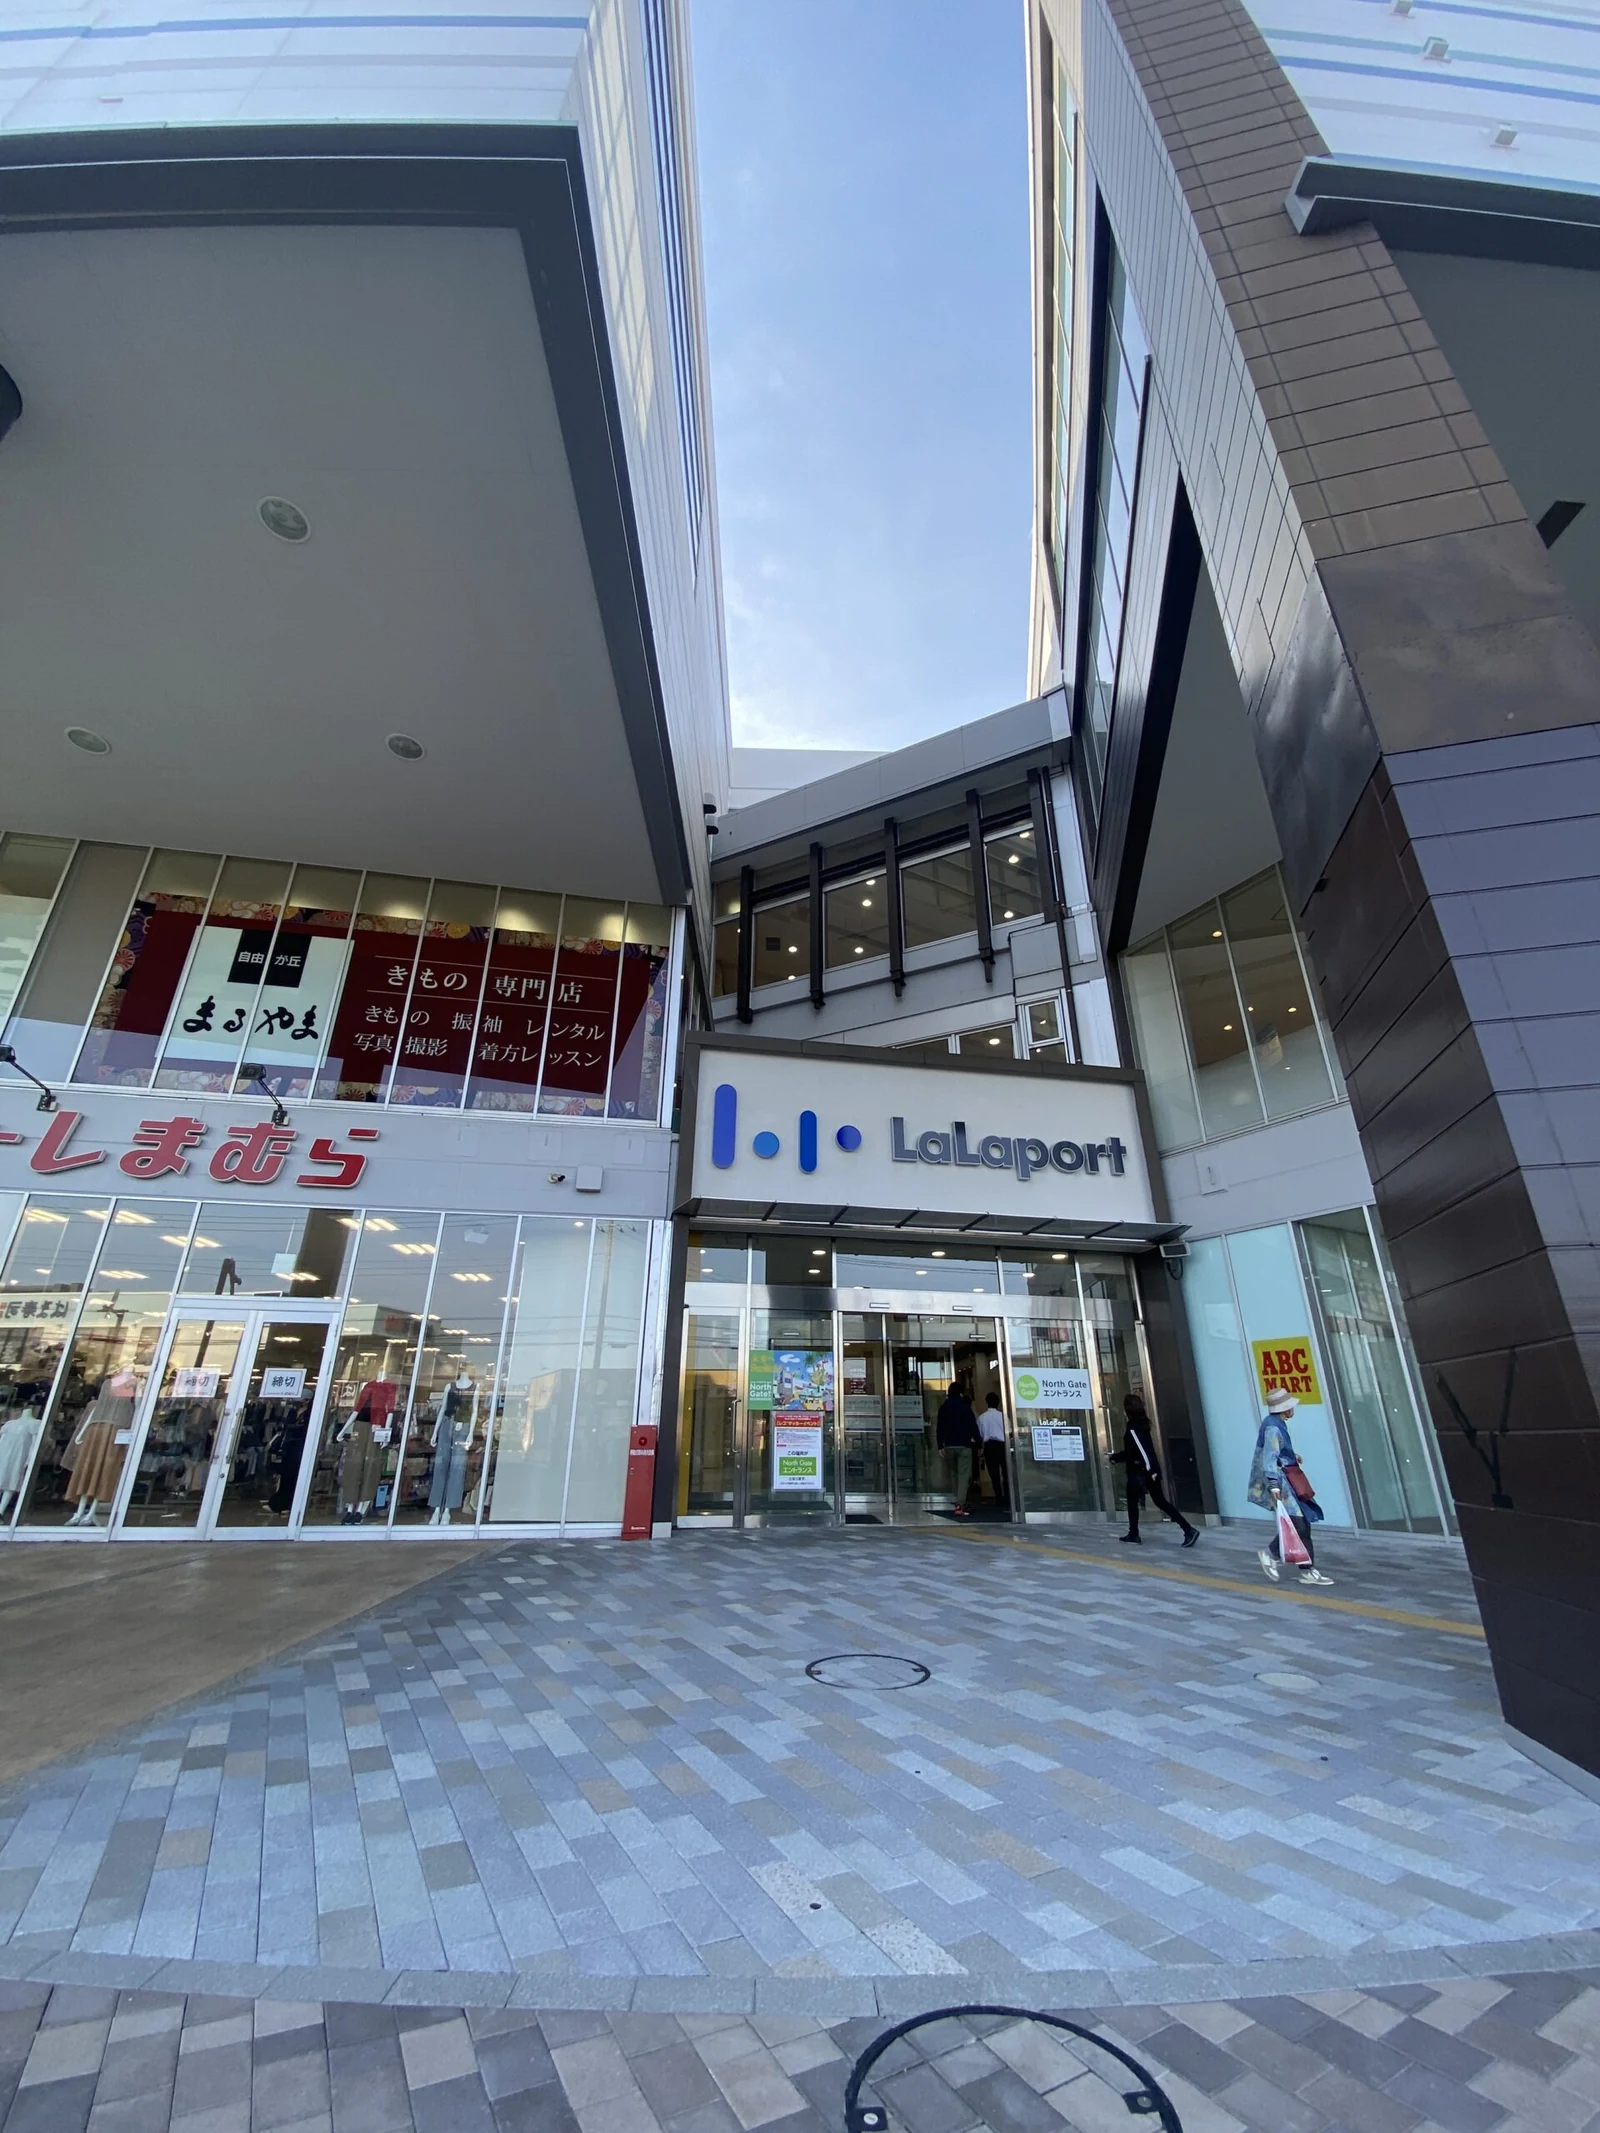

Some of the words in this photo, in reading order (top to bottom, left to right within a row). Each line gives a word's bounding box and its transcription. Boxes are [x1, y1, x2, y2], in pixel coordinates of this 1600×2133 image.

[238, 951, 301, 967] 自由が丘
[387, 965, 468, 990] きもの
[492, 975, 583, 1003] 専門店
[183, 995, 318, 1040] まるやま
[364, 1005, 430, 1026] きもの
[452, 1012, 503, 1033] 振袖
[526, 1019, 605, 1041] レンタル
[353, 1032, 448, 1057] 写真撮影
[478, 1042, 602, 1067] 着方レッスン
[890, 1116, 1127, 1181] LaLaport
[1262, 1348, 1308, 1375] ABC
[271, 1376, 295, 1387] 締切
[750, 1383, 772, 1391] North
[1042, 1380, 1065, 1388] North
[1068, 1380, 1087, 1389] Gate
[1264, 1376, 1312, 1393] MART
[1043, 1389, 1082, 1398] エントランス
